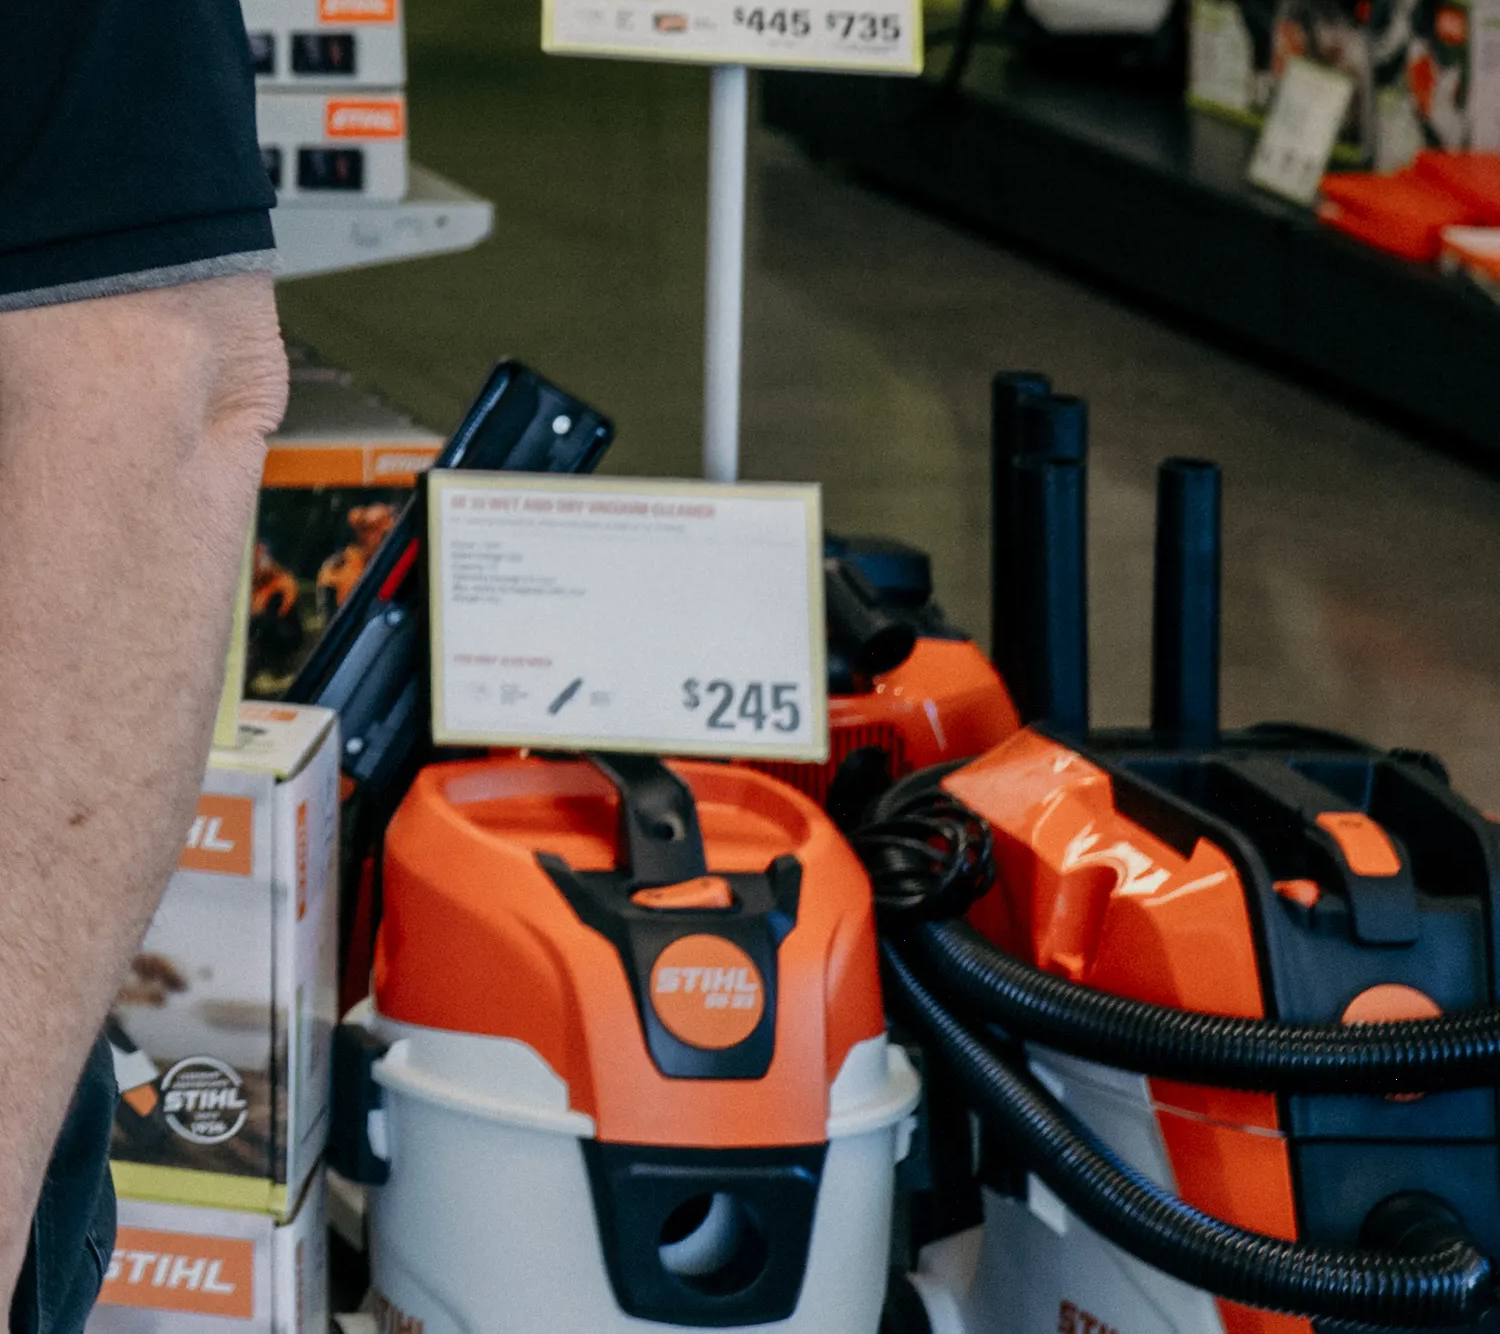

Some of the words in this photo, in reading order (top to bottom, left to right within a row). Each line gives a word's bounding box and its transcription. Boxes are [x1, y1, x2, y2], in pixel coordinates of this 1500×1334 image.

[733, 5, 811, 38] $445
[825, 9, 901, 41] $735
[681, 677, 801, 733] $245
[655, 966, 759, 994] STIHL
[163, 1087, 248, 1113] STIHL
